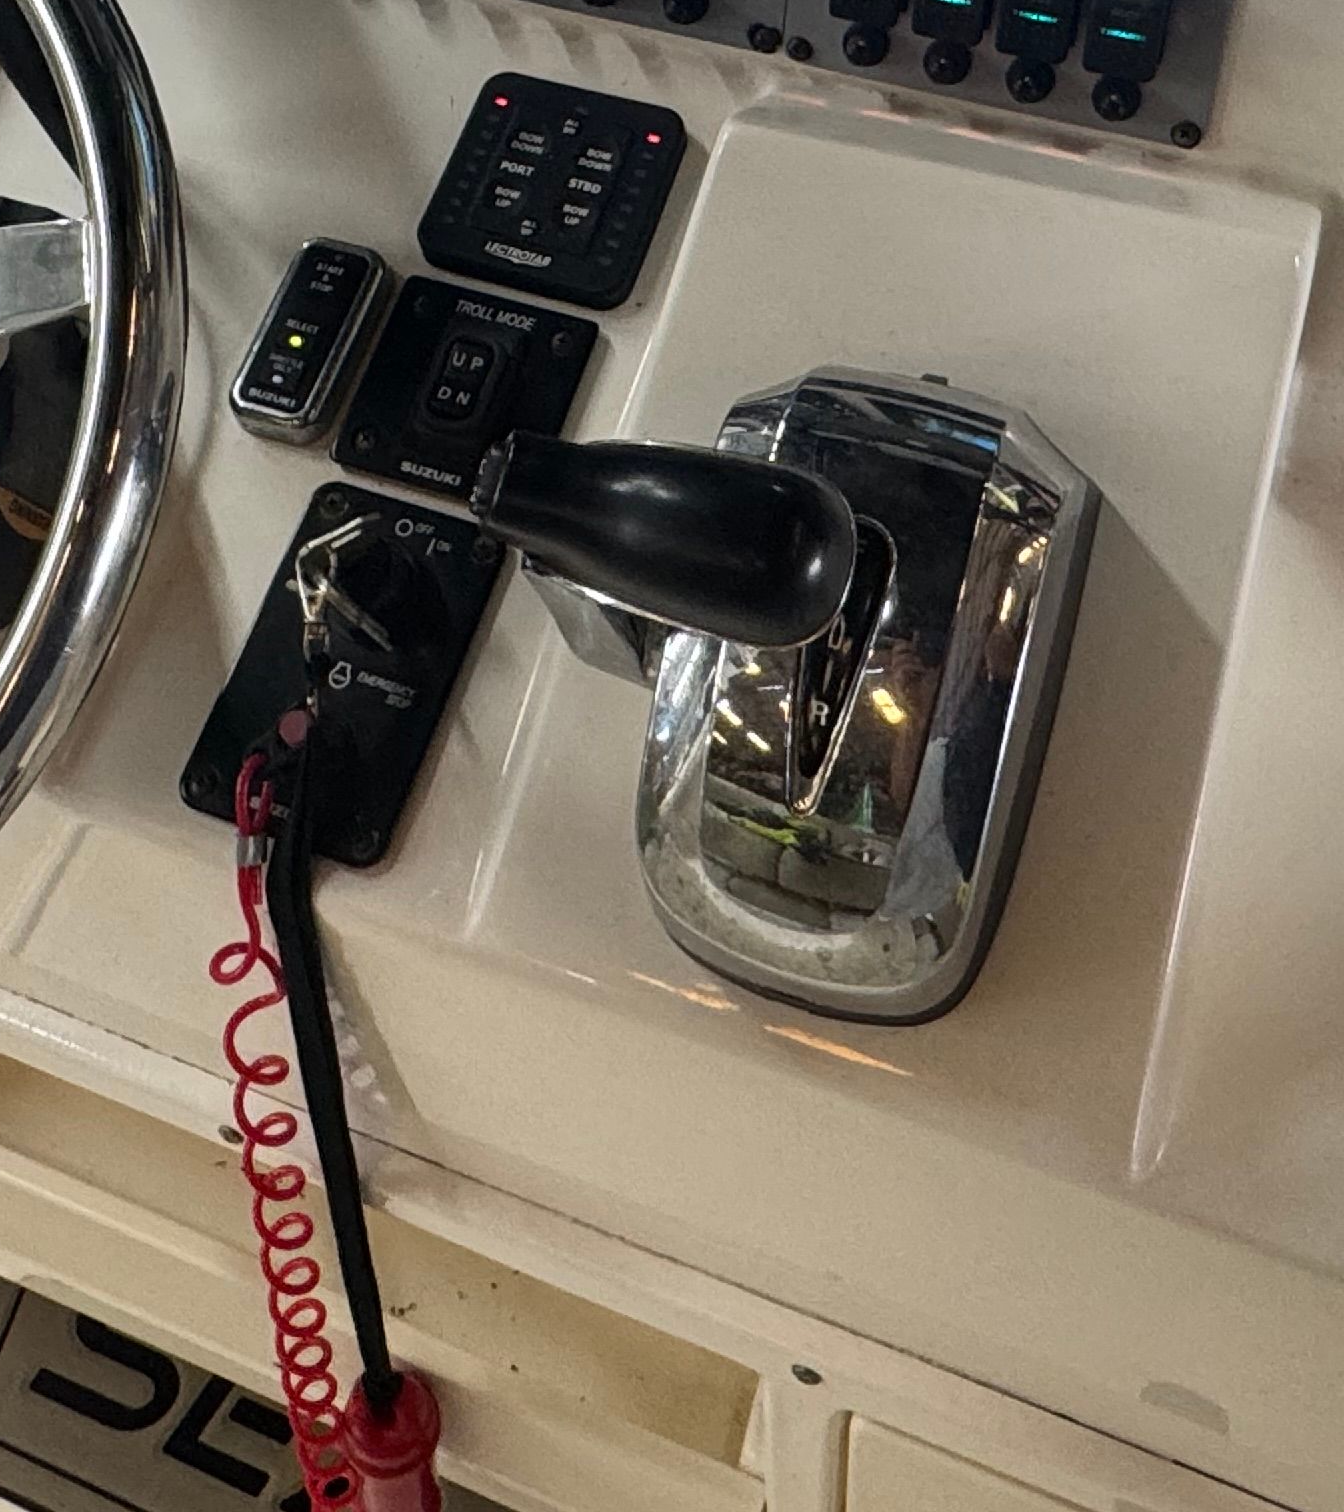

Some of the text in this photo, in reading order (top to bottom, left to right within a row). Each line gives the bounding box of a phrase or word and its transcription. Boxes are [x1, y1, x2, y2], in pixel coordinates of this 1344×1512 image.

[518, 132, 545, 145] BOW
[510, 140, 545, 155] DOWN
[586, 147, 614, 161] BOW
[500, 160, 536, 177] PORT
[577, 157, 612, 172] DOWN
[495, 186, 522, 200] BOW
[568, 177, 603, 195] STBD
[562, 204, 590, 218] BOW
[455, 299, 538, 332] TROLL MODE
[285, 318, 320, 335] SELECT
[450, 351, 485, 371] UP
[248, 386, 297, 408] SUZUKI
[436, 386, 472, 406] DN
[400, 460, 463, 487] SUZUKI
